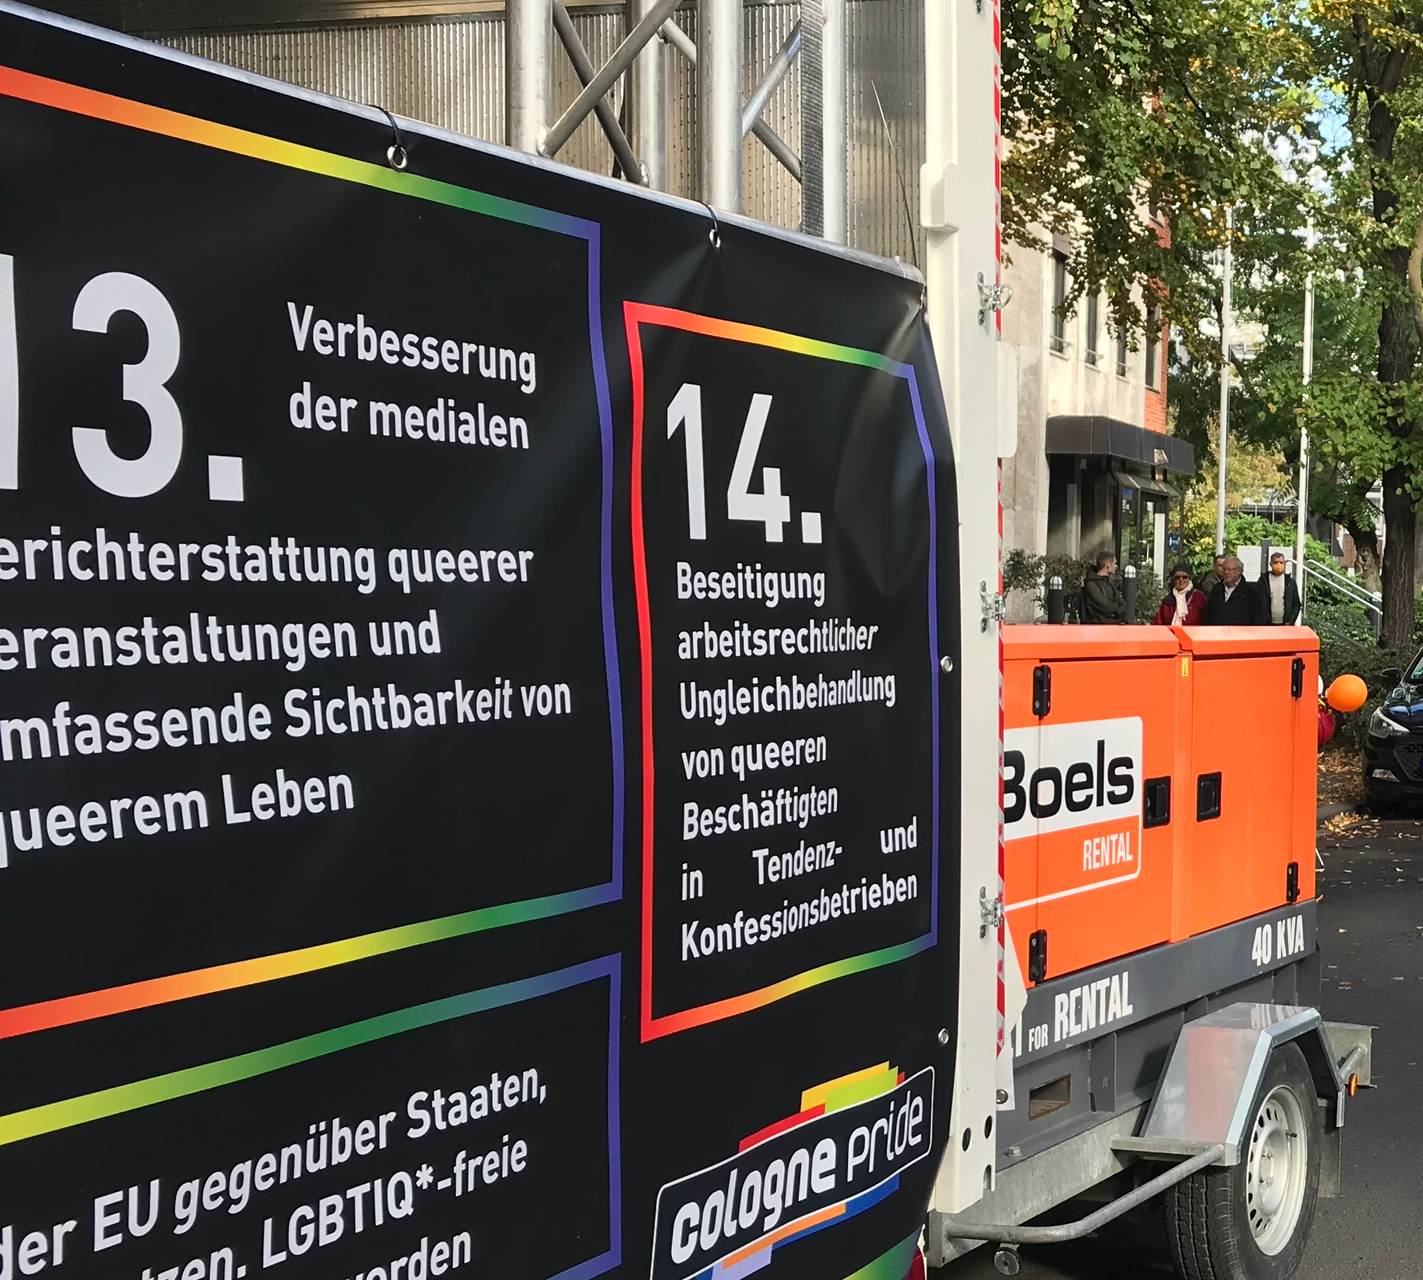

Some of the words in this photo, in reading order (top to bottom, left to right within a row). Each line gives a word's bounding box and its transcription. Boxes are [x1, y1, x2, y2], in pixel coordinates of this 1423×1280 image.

[287, 301, 537, 394] Verbesserung
[289, 382, 358, 432] der
[369, 394, 529, 449] medialen
[667, 383, 822, 544] 14.
[387, 546, 534, 594] queerer
[676, 561, 826, 608] Beseitigung
[369, 610, 441, 657] und
[678, 617, 879, 660] arbeitsrechtlicher
[283, 677, 513, 737] Sichtbarkeit
[520, 681, 572, 717] von
[679, 670, 896, 726] Ungleichbehandlung
[681, 747, 724, 780] von
[730, 735, 827, 781] queeren
[1003, 739, 1134, 824] Boels
[221, 768, 354, 825] Leben
[682, 786, 838, 840] Beschäftigten
[681, 863, 703, 901] in
[752, 839, 843, 885] Tendenz-
[879, 816, 918, 854] und
[1083, 832, 1134, 871] RENTAL
[681, 873, 918, 961] Konfessionsbetrieben
[1252, 924, 1272, 966] 40
[1277, 915, 1304, 959] KVA
[1028, 1023, 1048, 1052] FOR
[1054, 971, 1133, 1042] RENTAL
[94, 1179, 160, 1252] EU
[173, 1111, 397, 1235] gegenüber
[406, 1067, 547, 1139] Staaten,
[671, 1137, 837, 1264] cologne
